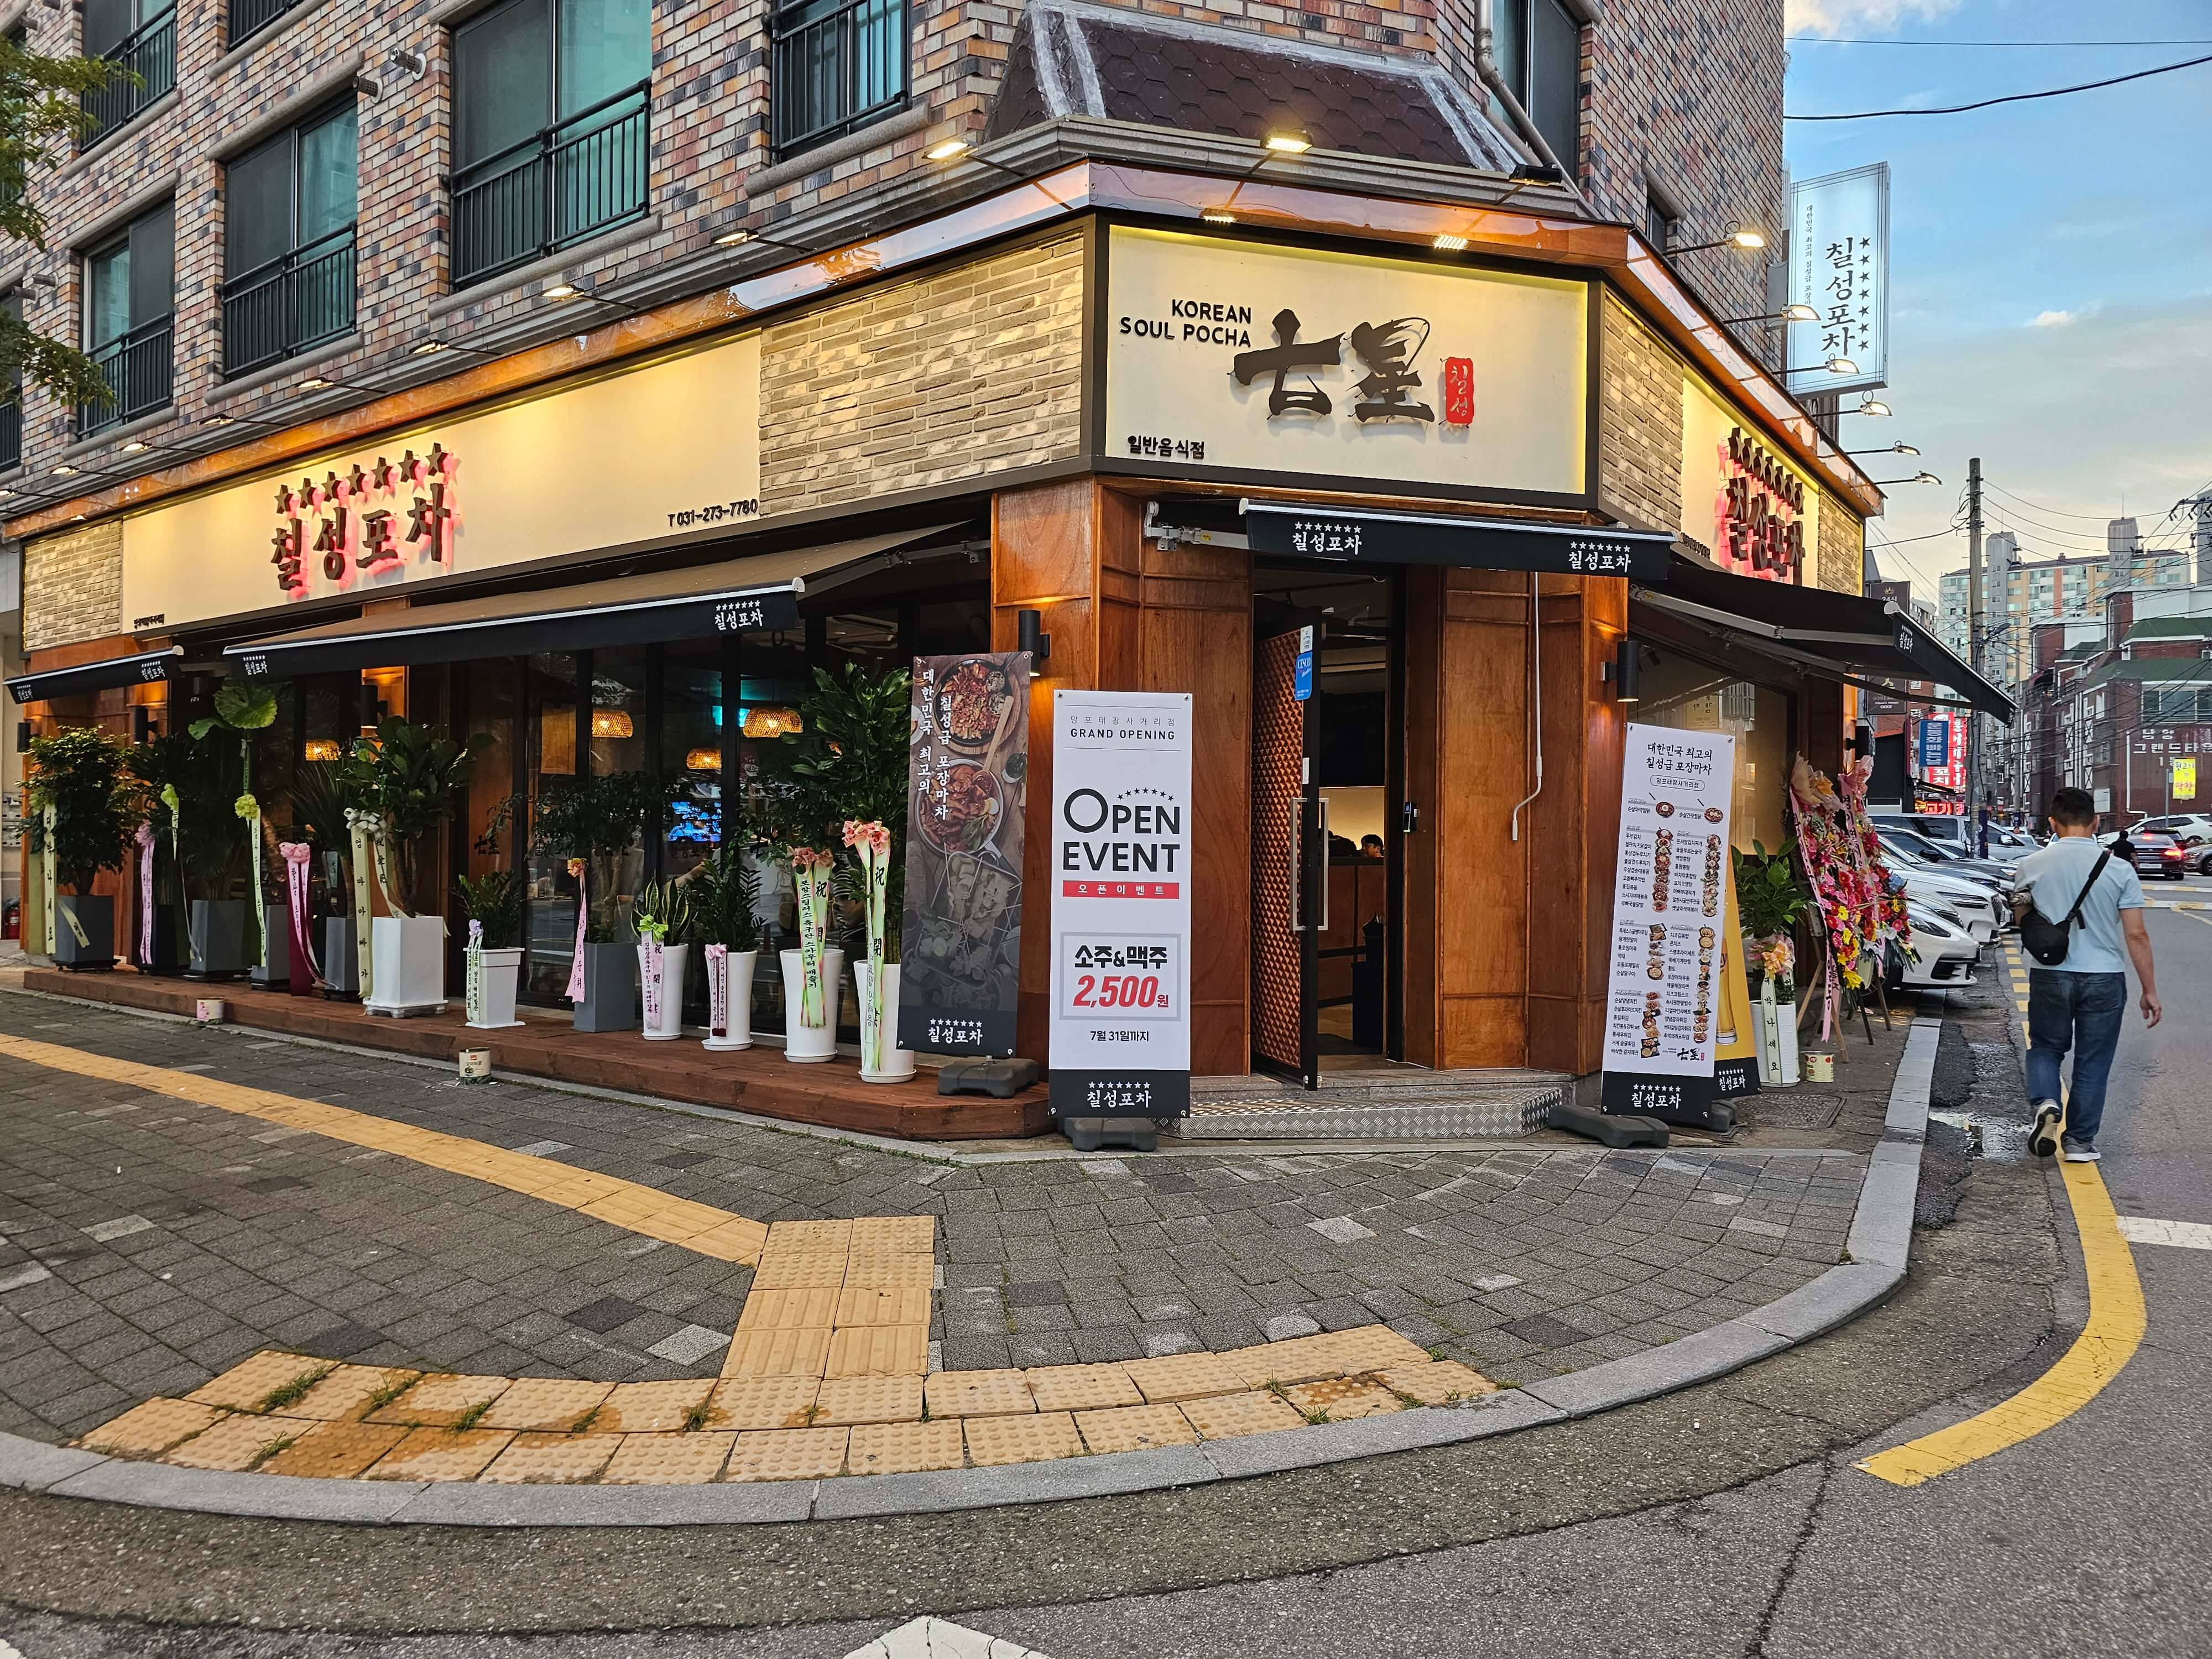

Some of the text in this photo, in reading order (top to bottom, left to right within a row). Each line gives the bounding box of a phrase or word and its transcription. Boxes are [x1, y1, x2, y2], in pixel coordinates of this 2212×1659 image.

[1821, 237, 1857, 356] 칠성포차
[1171, 299, 1252, 325] KOREAN
[1119, 316, 1252, 348] SOUL POCHA
[1227, 309, 1435, 424] 七星
[1448, 366, 1469, 419] 칠성
[1127, 435, 1206, 460] 일반음식점
[667, 499, 758, 528] T 031-273-7780
[270, 483, 451, 592] 칠성포차
[1724, 476, 1806, 586] 칠성포차
[1292, 533, 1363, 555] 칠성포차
[1568, 551, 1632, 573] 칠성포차
[714, 610, 764, 631] 칠성포차
[141, 665, 166, 681] 칠성포차
[244, 660, 268, 676] 칠성포차
[917, 668, 935, 795] 대한민국 최고의
[1070, 716, 1175, 727] 망포태장사거리점
[1070, 728, 1175, 740] GRAND OPENING
[2142, 729, 2175, 740] 남양
[935, 695, 952, 821] 칠성급 포장마차
[1647, 742, 1713, 761] 대한민국 최고의
[2133, 743, 2212, 753] 그랜드타운
[1646, 757, 1713, 775] 칠성급 포장마차
[1656, 777, 1699, 789] 망포태장사거리점
[1063, 787, 1181, 834] OPEN
[1062, 842, 1181, 873] EVENT
[1077, 884, 1165, 896] 오픈이벤트
[1074, 945, 1168, 969] 소주&맥주
[1073, 975, 1169, 1009] 2,500원
[927, 1026, 983, 1046] 칠성포차
[1089, 1030, 1150, 1042] 7월 31일까지
[1719, 1074, 1746, 1092] 칠성포차
[1087, 1089, 1152, 1108] 칠성포차
[1631, 1091, 1682, 1110] 칠성포차
